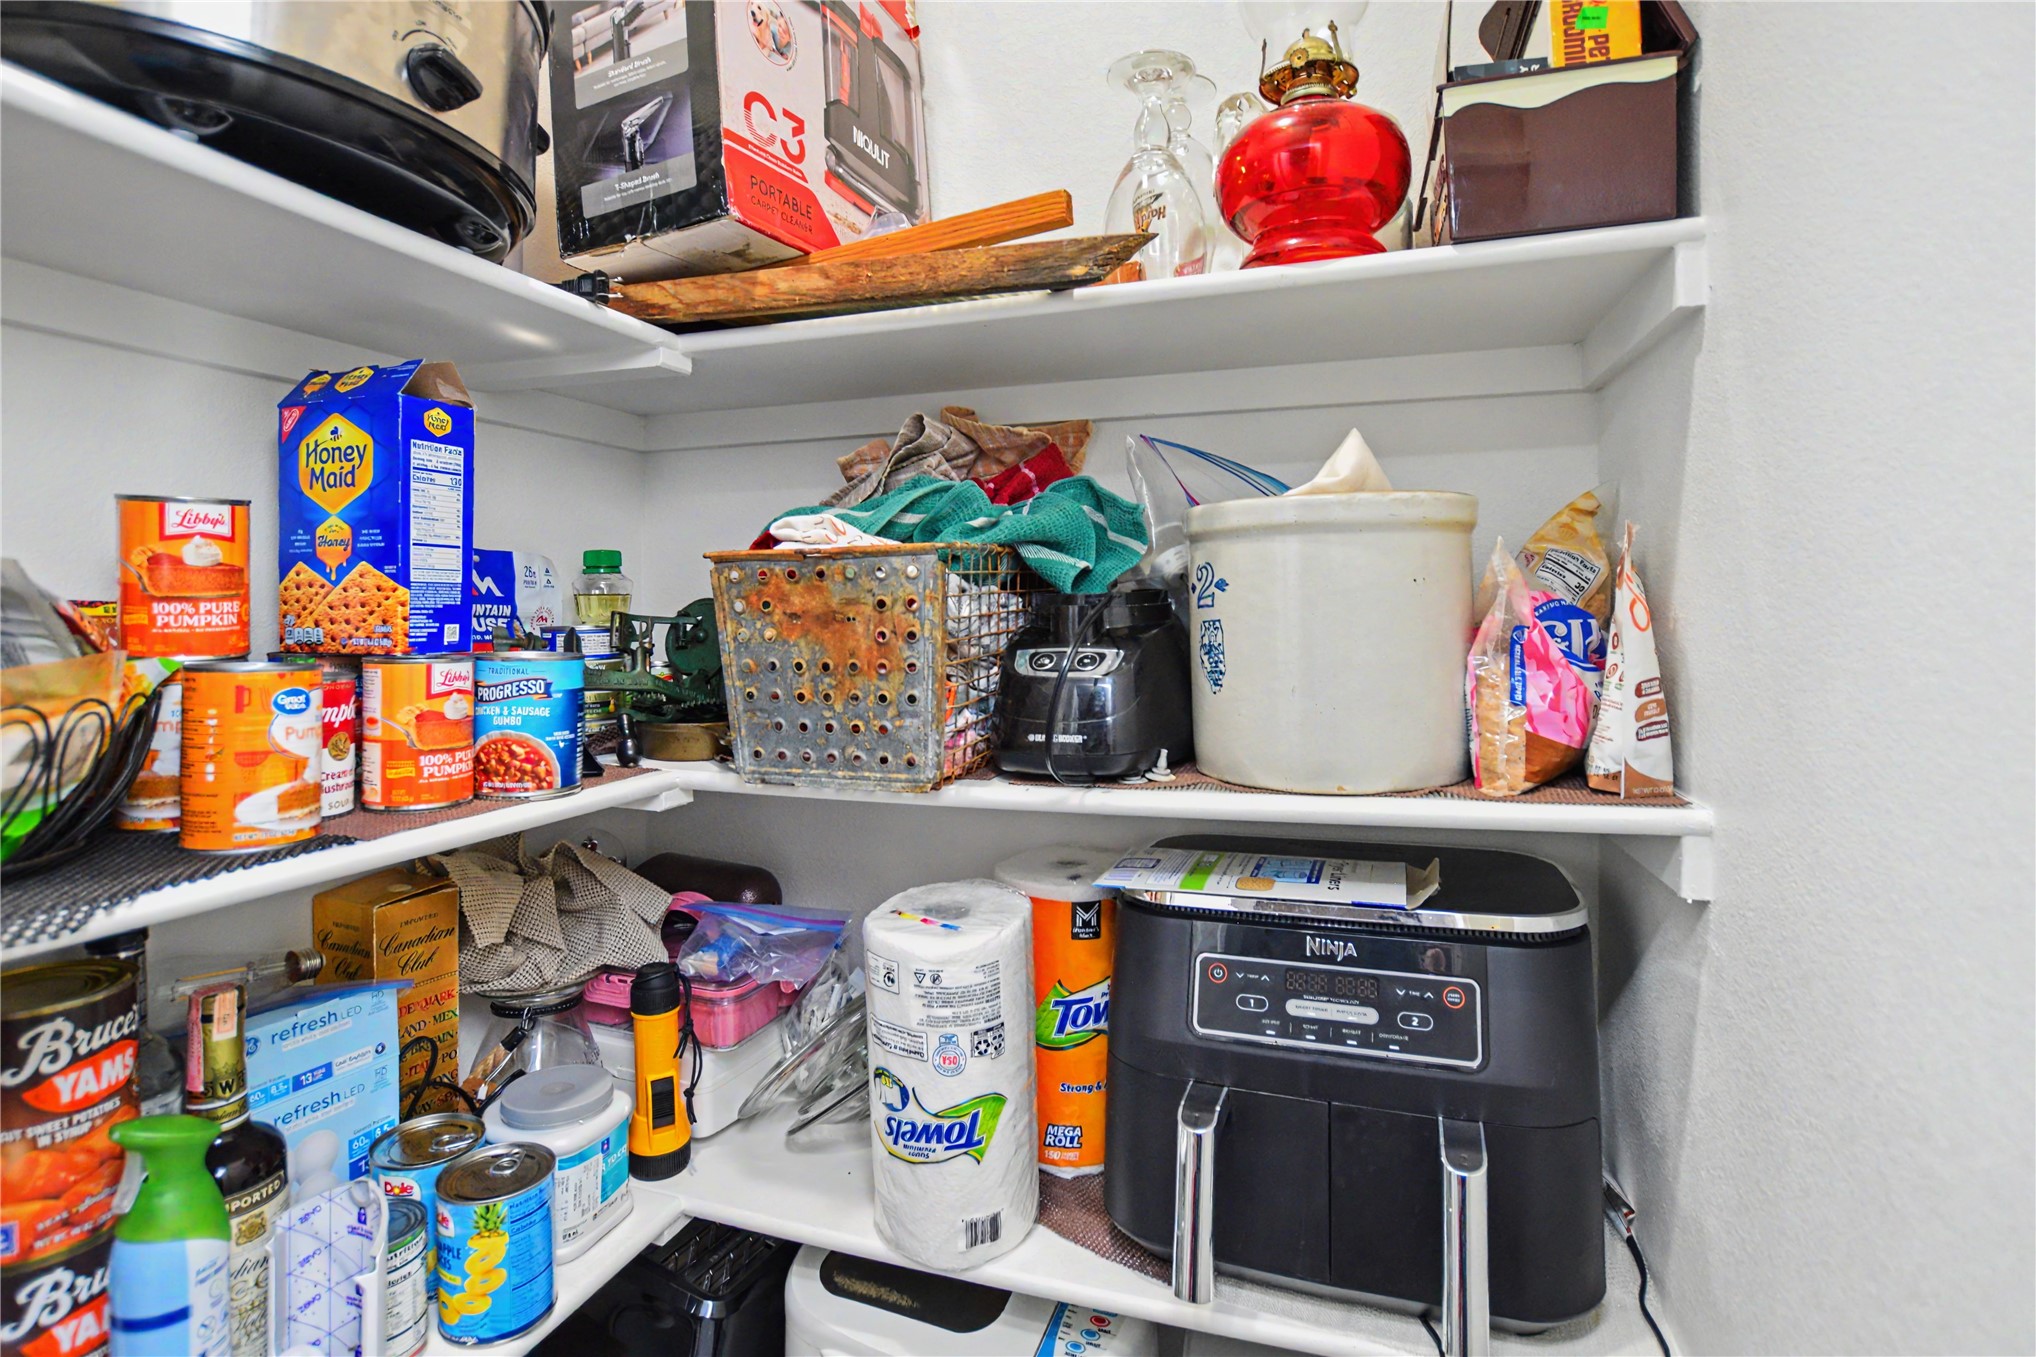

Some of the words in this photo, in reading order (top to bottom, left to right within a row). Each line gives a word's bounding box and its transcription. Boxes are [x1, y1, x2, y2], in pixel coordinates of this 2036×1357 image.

[1562, 0, 1587, 67] ROOMI
[1588, 33, 1611, 62] Pe
[743, 91, 806, 165] C3
[852, 125, 890, 169] NIQULIT
[750, 175, 812, 220] PORTABLE
[305, 440, 367, 470] Honey
[308, 465, 357, 491] Maid
[171, 508, 225, 529] Libby's
[317, 535, 350, 552] Honey
[1196, 562, 1215, 609] 2
[152, 602, 196, 615] 100%
[199, 601, 241, 614] PURE
[473, 604, 512, 616] NTAIN
[156, 614, 238, 627] PUMPKIN
[488, 667, 529, 675] TRADITIONAL
[477, 679, 546, 702] PROGRESSO
[493, 716, 522, 726] GUMBO
[511, 706, 551, 717] SAUSAGE
[419, 754, 452, 767] 100%
[317, 929, 371, 960] Canadian
[379, 925, 455, 958] Canadian
[1306, 935, 1358, 961] NINJA
[398, 946, 440, 976] Club
[271, 1010, 338, 1045] refresh
[341, 1004, 363, 1020] LED
[1411, 1016, 1419, 1027] 2
[53, 1046, 135, 1105] YAMS
[219, 1079, 235, 1095] W
[300, 1073, 313, 1086] 13
[1060, 1081, 1093, 1094] Strong
[273, 1091, 341, 1128] refresh
[343, 1083, 366, 1099] LED
[26, 1117, 70, 1139] SWEET
[885, 1108, 985, 1152] Towels
[1047, 1124, 1082, 1136] MEGA
[1046, 1134, 1081, 1148] ROLL
[225, 1180, 283, 1213] PORTED
[385, 1181, 414, 1194] Dole
